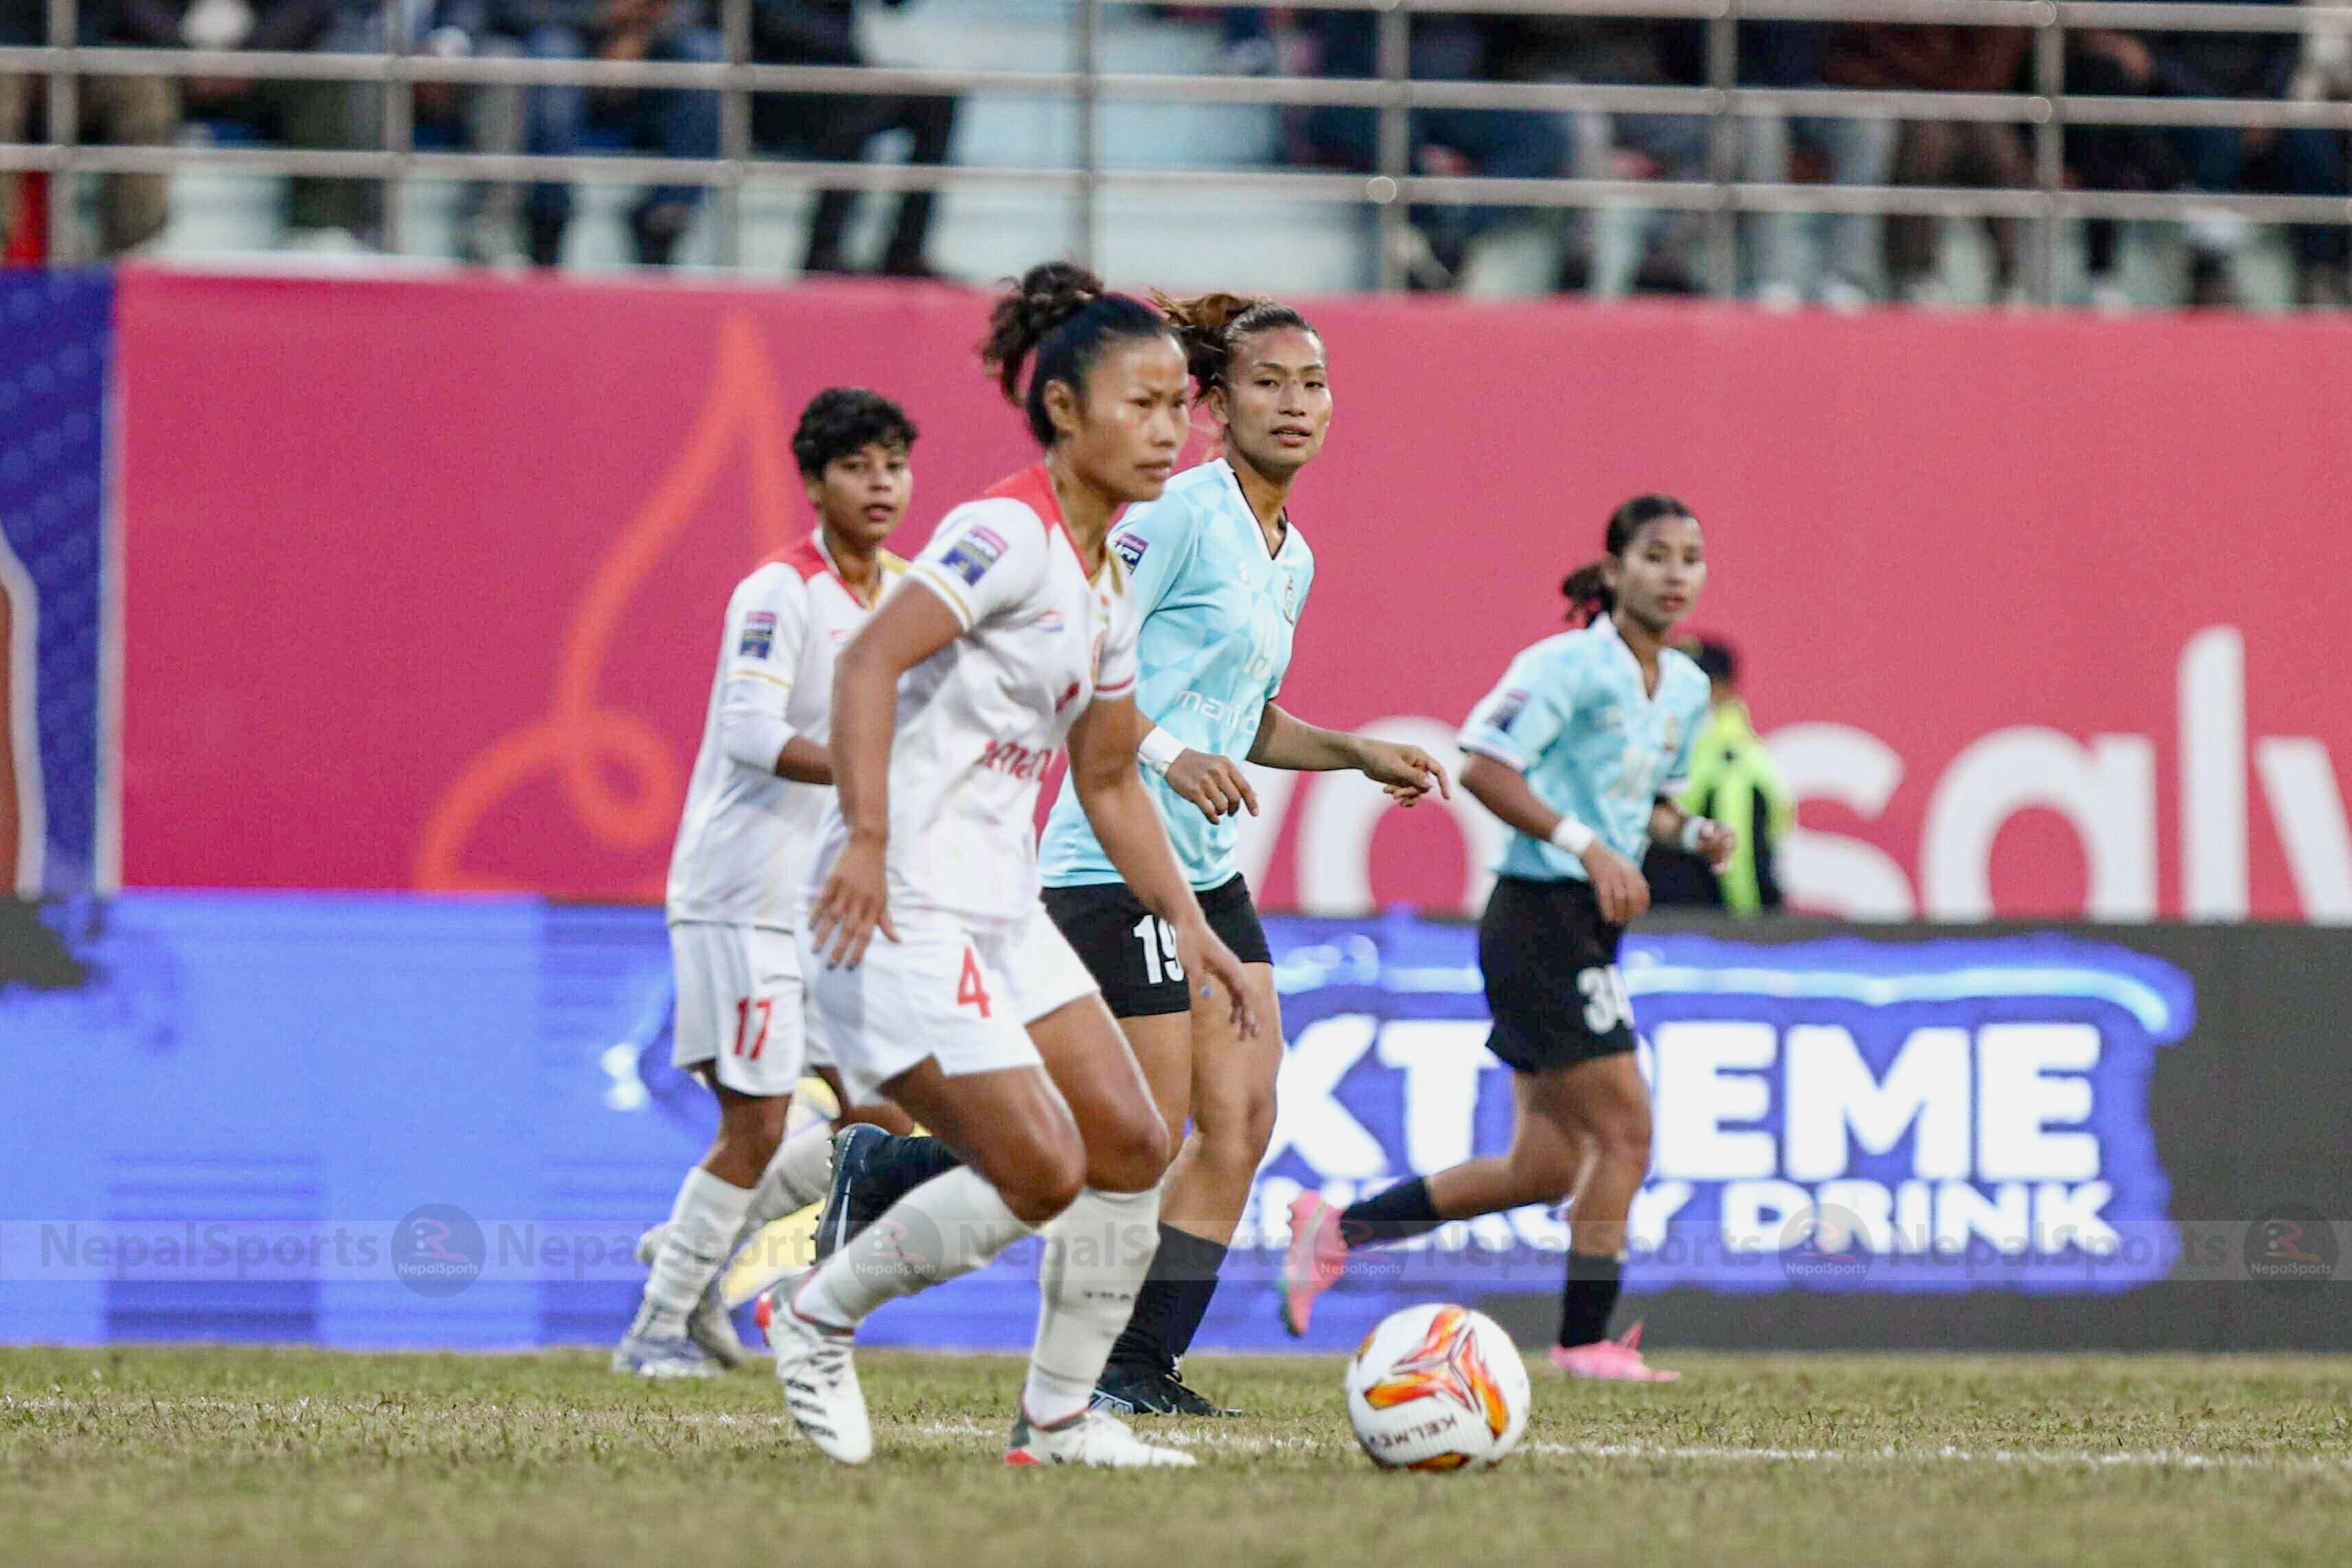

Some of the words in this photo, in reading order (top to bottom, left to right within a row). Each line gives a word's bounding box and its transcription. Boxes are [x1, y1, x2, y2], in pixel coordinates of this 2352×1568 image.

[957, 946, 991, 1018] 4
[1133, 914, 1185, 984] 19
[733, 997, 773, 1061] 17
[1259, 1013, 2101, 1180] XTEME
[1720, 1182, 2121, 1255] DRINK
